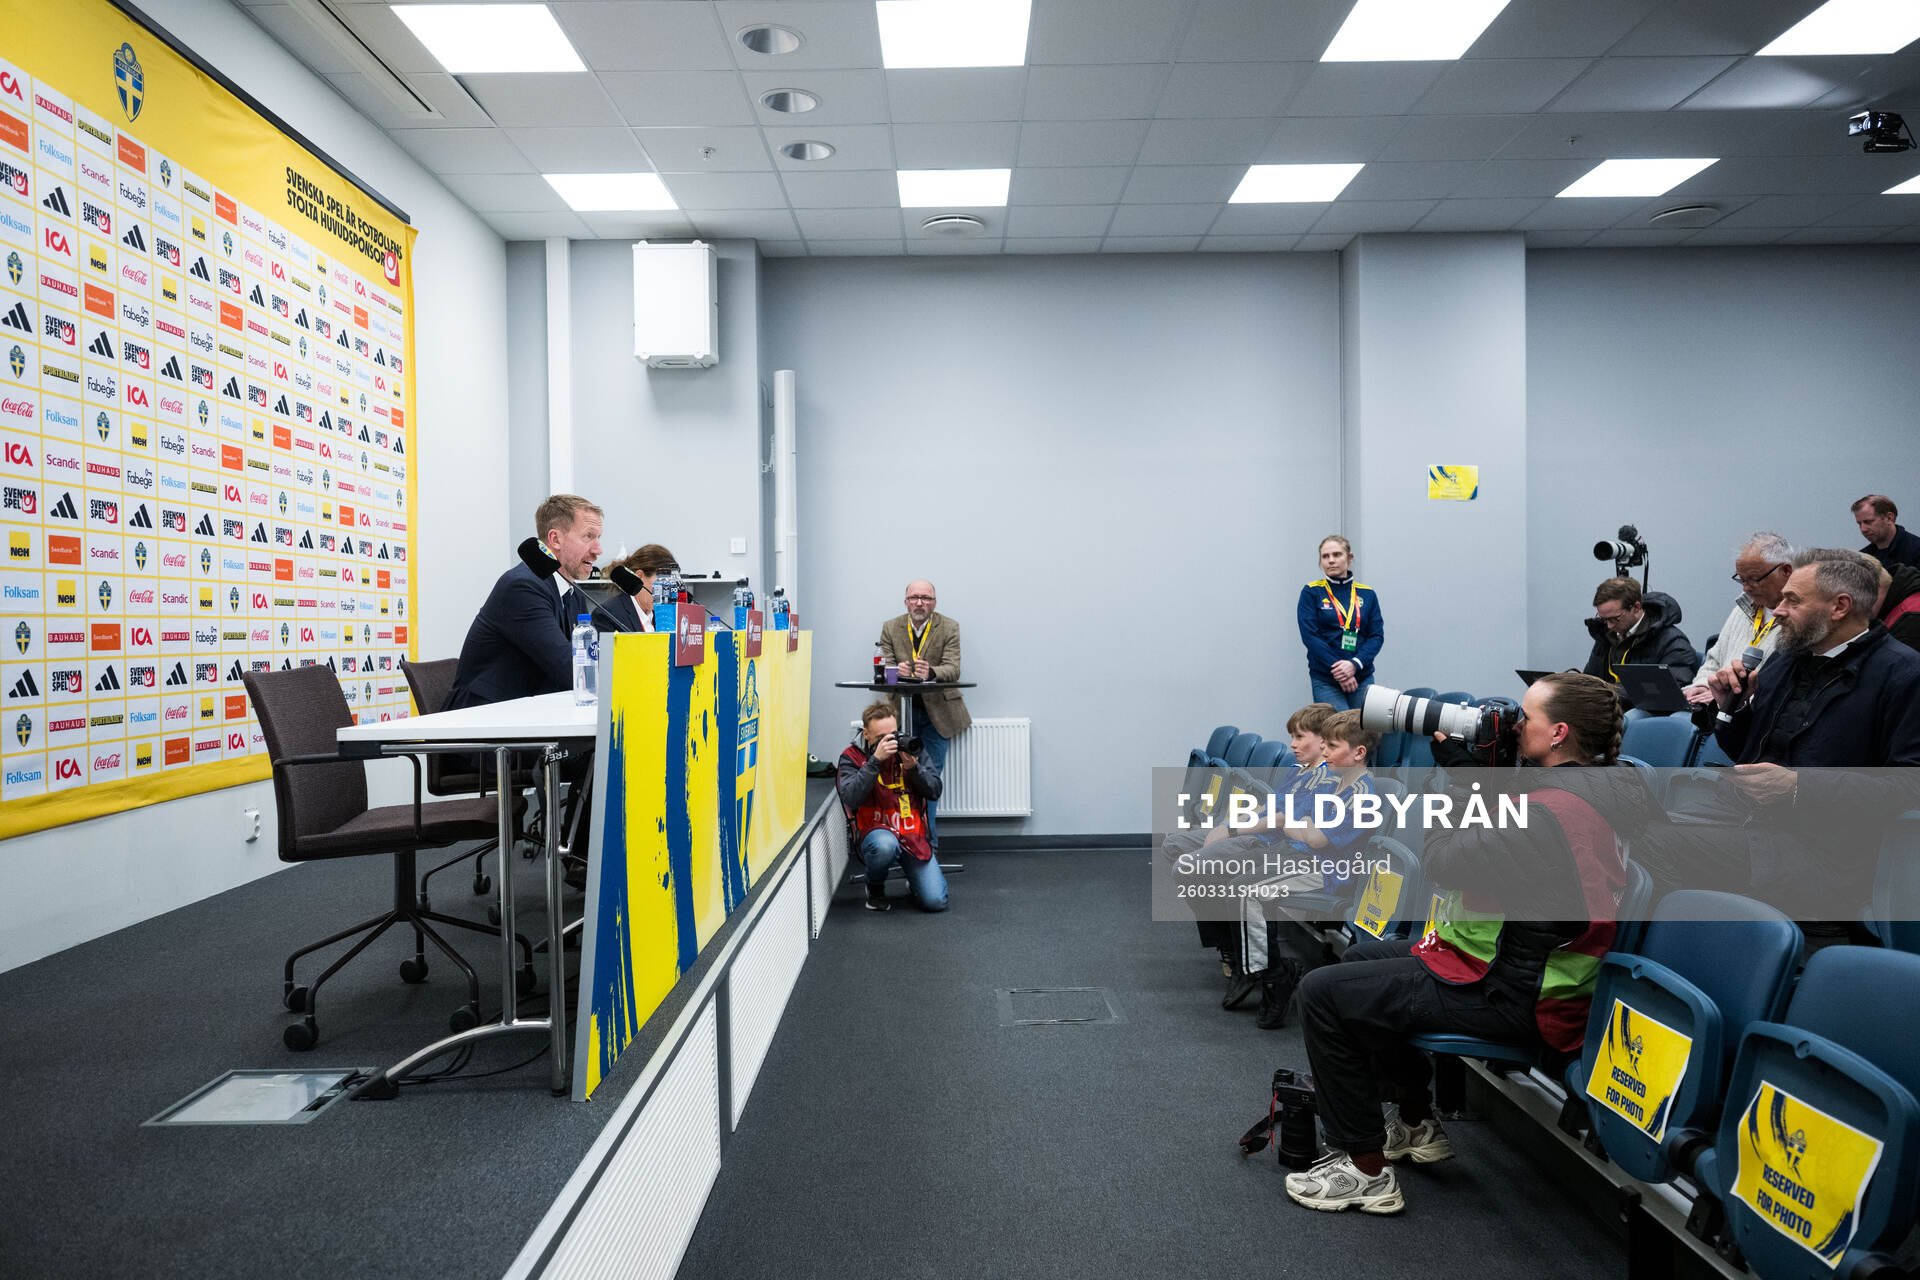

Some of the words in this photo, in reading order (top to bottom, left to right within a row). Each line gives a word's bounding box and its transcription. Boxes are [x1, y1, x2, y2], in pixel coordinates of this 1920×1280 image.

[0, 72, 23, 101] CA
[35, 94, 72, 124] BAUHAUS
[40, 140, 72, 166] Folksam
[0, 161, 28, 182] VENSKA
[81, 164, 110, 187] Scandic
[0, 173, 12, 188] PEL
[120, 183, 145, 208] Fabege
[83, 202, 110, 221] SVENSKA
[155, 202, 179, 224] Folksam
[286, 166, 324, 205] SVENSKA
[327, 198, 343, 221] SPEL
[346, 207, 357, 229] ÄR
[358, 218, 403, 260] FOTBOLLENS
[84, 212, 98, 227] SPEL
[287, 188, 318, 224] STOLTA
[321, 215, 385, 267] HUVUDSPONSOR
[46, 228, 71, 257] ICA
[157, 238, 180, 252] SVENSKA
[157, 247, 170, 260] SPEL
[122, 265, 147, 285] Coca-Cola
[272, 261, 286, 282] ICA
[41, 274, 77, 297] BAUHAUS
[219, 277, 231, 289] SPEL
[355, 280, 366, 298] ICA
[190, 295, 213, 311] Scandic
[45, 315, 75, 331] SVENSKA
[123, 305, 149, 326] Fabege
[46, 326, 61, 339] SPEL
[156, 320, 185, 339] BAUHAUS
[124, 342, 149, 357] SVENSKA
[191, 332, 213, 352] Fabege
[124, 351, 138, 364] SPEL
[191, 365, 213, 377] SVENSKA
[274, 362, 288, 381] ICA
[192, 373, 203, 385] SPEL
[375, 376, 386, 391] ICA
[88, 377, 115, 398] Fabege
[127, 385, 149, 407] ICA
[2, 398, 33, 418] Coca-Cola
[46, 410, 78, 427] Folksam
[161, 436, 184, 454] Fabege
[191, 444, 215, 458] Scandic
[319, 443, 332, 459] ICA
[5, 442, 33, 467] ICA
[46, 454, 80, 470] Scandic
[86, 462, 120, 478] BAUHAUS
[127, 470, 152, 489] Fabege
[161, 476, 186, 490] Folksam
[4, 487, 36, 500] SVENSKA
[225, 485, 242, 503] ICA
[4, 497, 21, 509] SPEL
[90, 499, 118, 511] SVENSKA
[91, 510, 105, 520] SPEL
[163, 510, 185, 521] SVENSKA
[360, 513, 371, 527] ICA
[163, 518, 174, 529] SPEL
[223, 518, 243, 529] SVENSKA
[224, 527, 234, 536] SPEL
[91, 547, 119, 559] Scandic
[163, 553, 186, 567] Coca-Cola
[342, 568, 354, 582] ICA
[4, 586, 39, 600] Folksam
[129, 590, 154, 603] Coca-Cola
[163, 594, 188, 604] Scandic
[253, 593, 268, 608] ICA
[48, 633, 85, 643] BAUHAUS
[131, 628, 152, 646] ICA
[161, 632, 190, 642] BAUHAUS
[196, 631, 217, 645] Fabege
[301, 627, 314, 642] ICA
[130, 667, 155, 676] SVENSKA
[196, 663, 217, 672] SVENSKA
[52, 671, 82, 681] SVENSKA
[131, 676, 144, 686] SPEL
[196, 672, 207, 681] SPEL
[52, 680, 68, 692] SPEL
[130, 711, 157, 723] Folksam
[165, 705, 188, 720] Coca-Cola
[380, 713, 391, 721] ICA
[49, 718, 86, 732] BAUHAUS
[195, 740, 221, 753] BAUHAUS
[228, 733, 245, 749] ICA
[56, 758, 81, 780] ICA
[94, 753, 121, 771] Coca-Cola
[6, 770, 42, 785] Folksam
[1611, 1065, 1646, 1098] RESERVED
[1606, 1087, 1620, 1108] FOR
[1621, 1098, 1643, 1122] PHOTO
[1763, 1164, 1815, 1210] RESERVED
[1757, 1189, 1771, 1215] FOR
[1771, 1201, 1812, 1239] PHOTO
